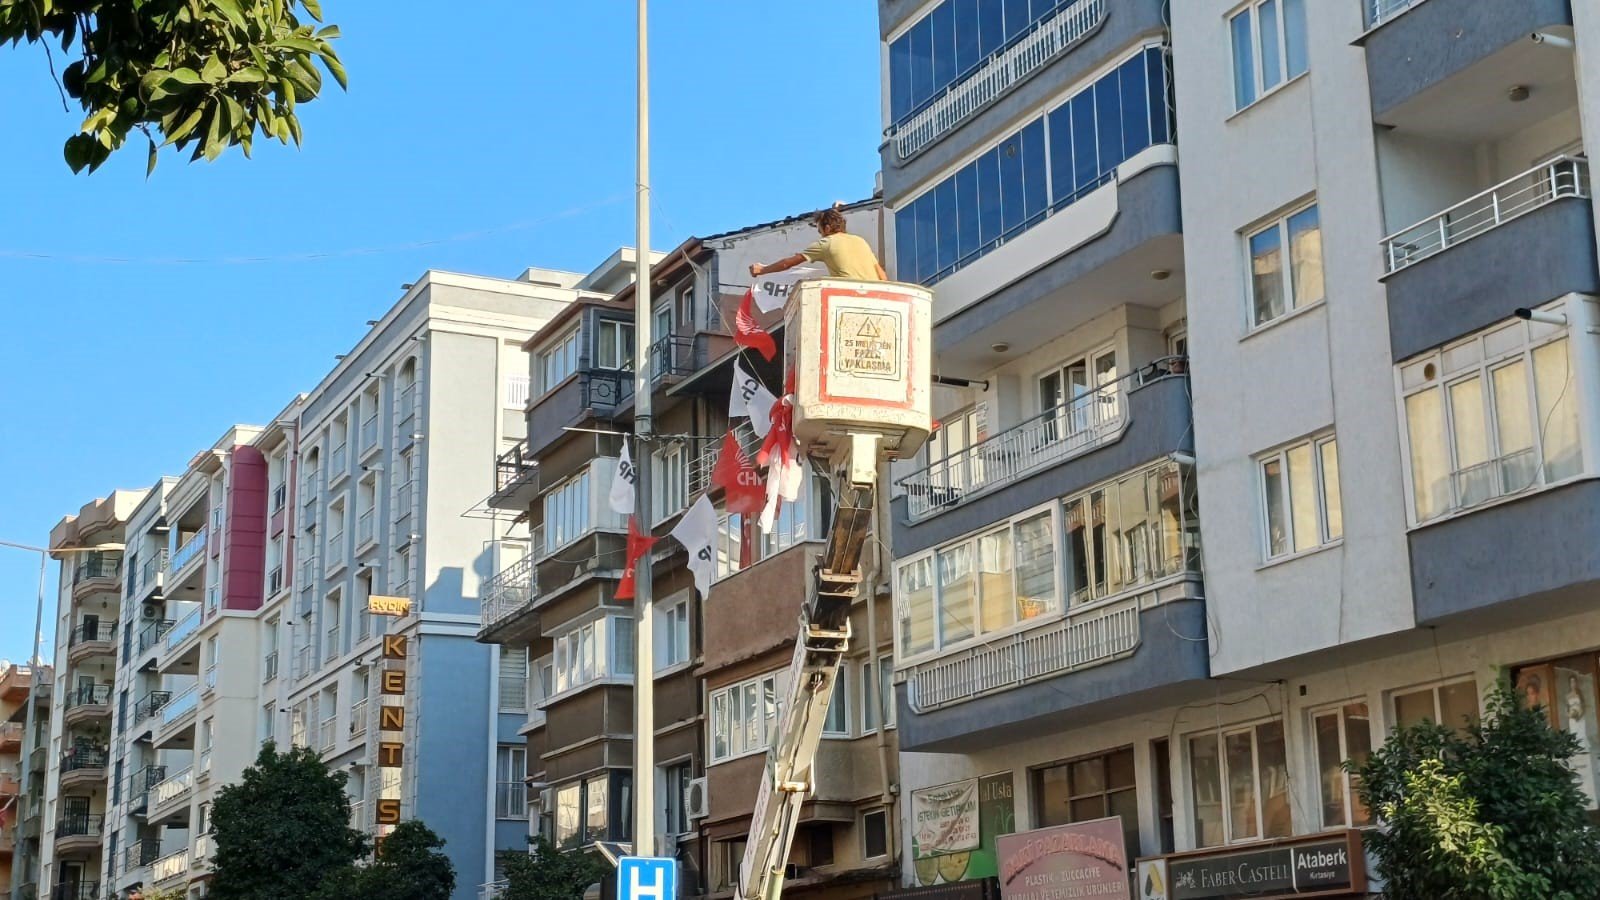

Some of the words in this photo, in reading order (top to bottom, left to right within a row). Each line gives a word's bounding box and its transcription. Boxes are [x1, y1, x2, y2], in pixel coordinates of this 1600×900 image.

[844, 339, 853, 347] 25
[381, 635, 405, 764] KENT
[992, 781, 1013, 799] Usta
[1297, 848, 1347, 870] Ataberk
[630, 866, 664, 900] H
